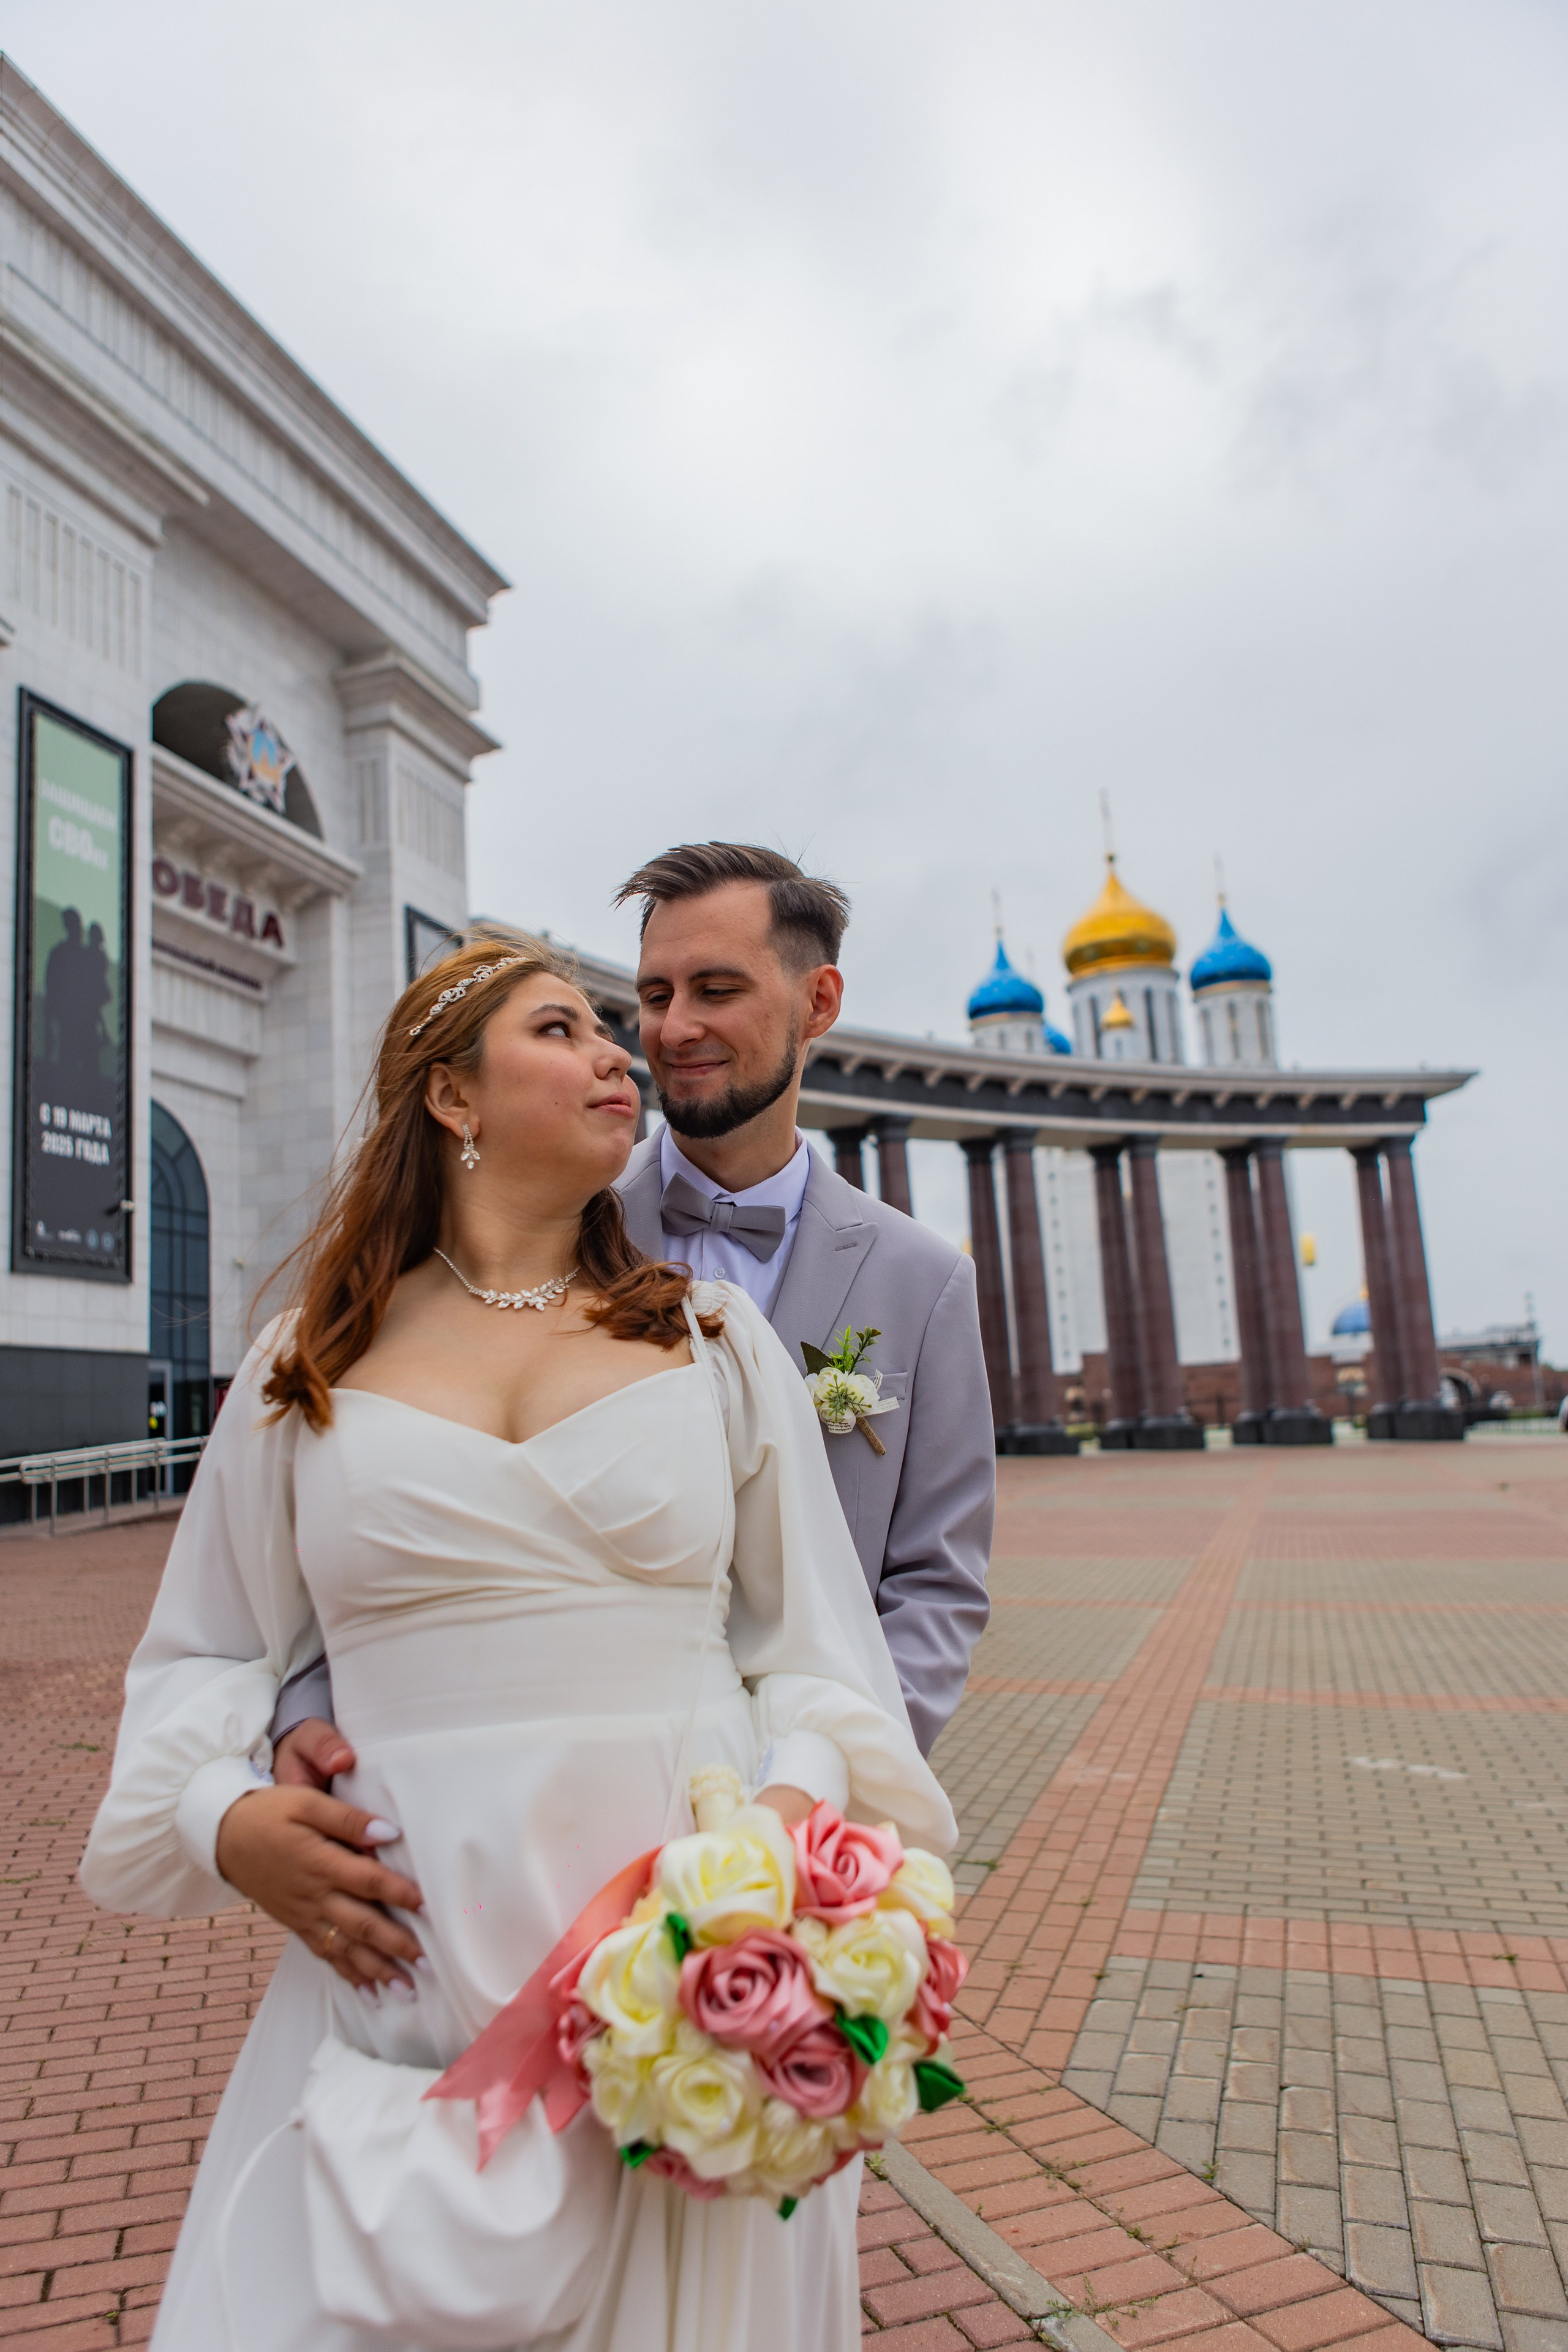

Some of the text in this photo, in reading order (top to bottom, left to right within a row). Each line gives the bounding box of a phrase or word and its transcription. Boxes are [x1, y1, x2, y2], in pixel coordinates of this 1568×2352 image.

[40, 1102, 51, 1126] С
[69, 1109, 111, 1140] МАРТА
[41, 1130, 110, 1166] 2025 ГОДА
